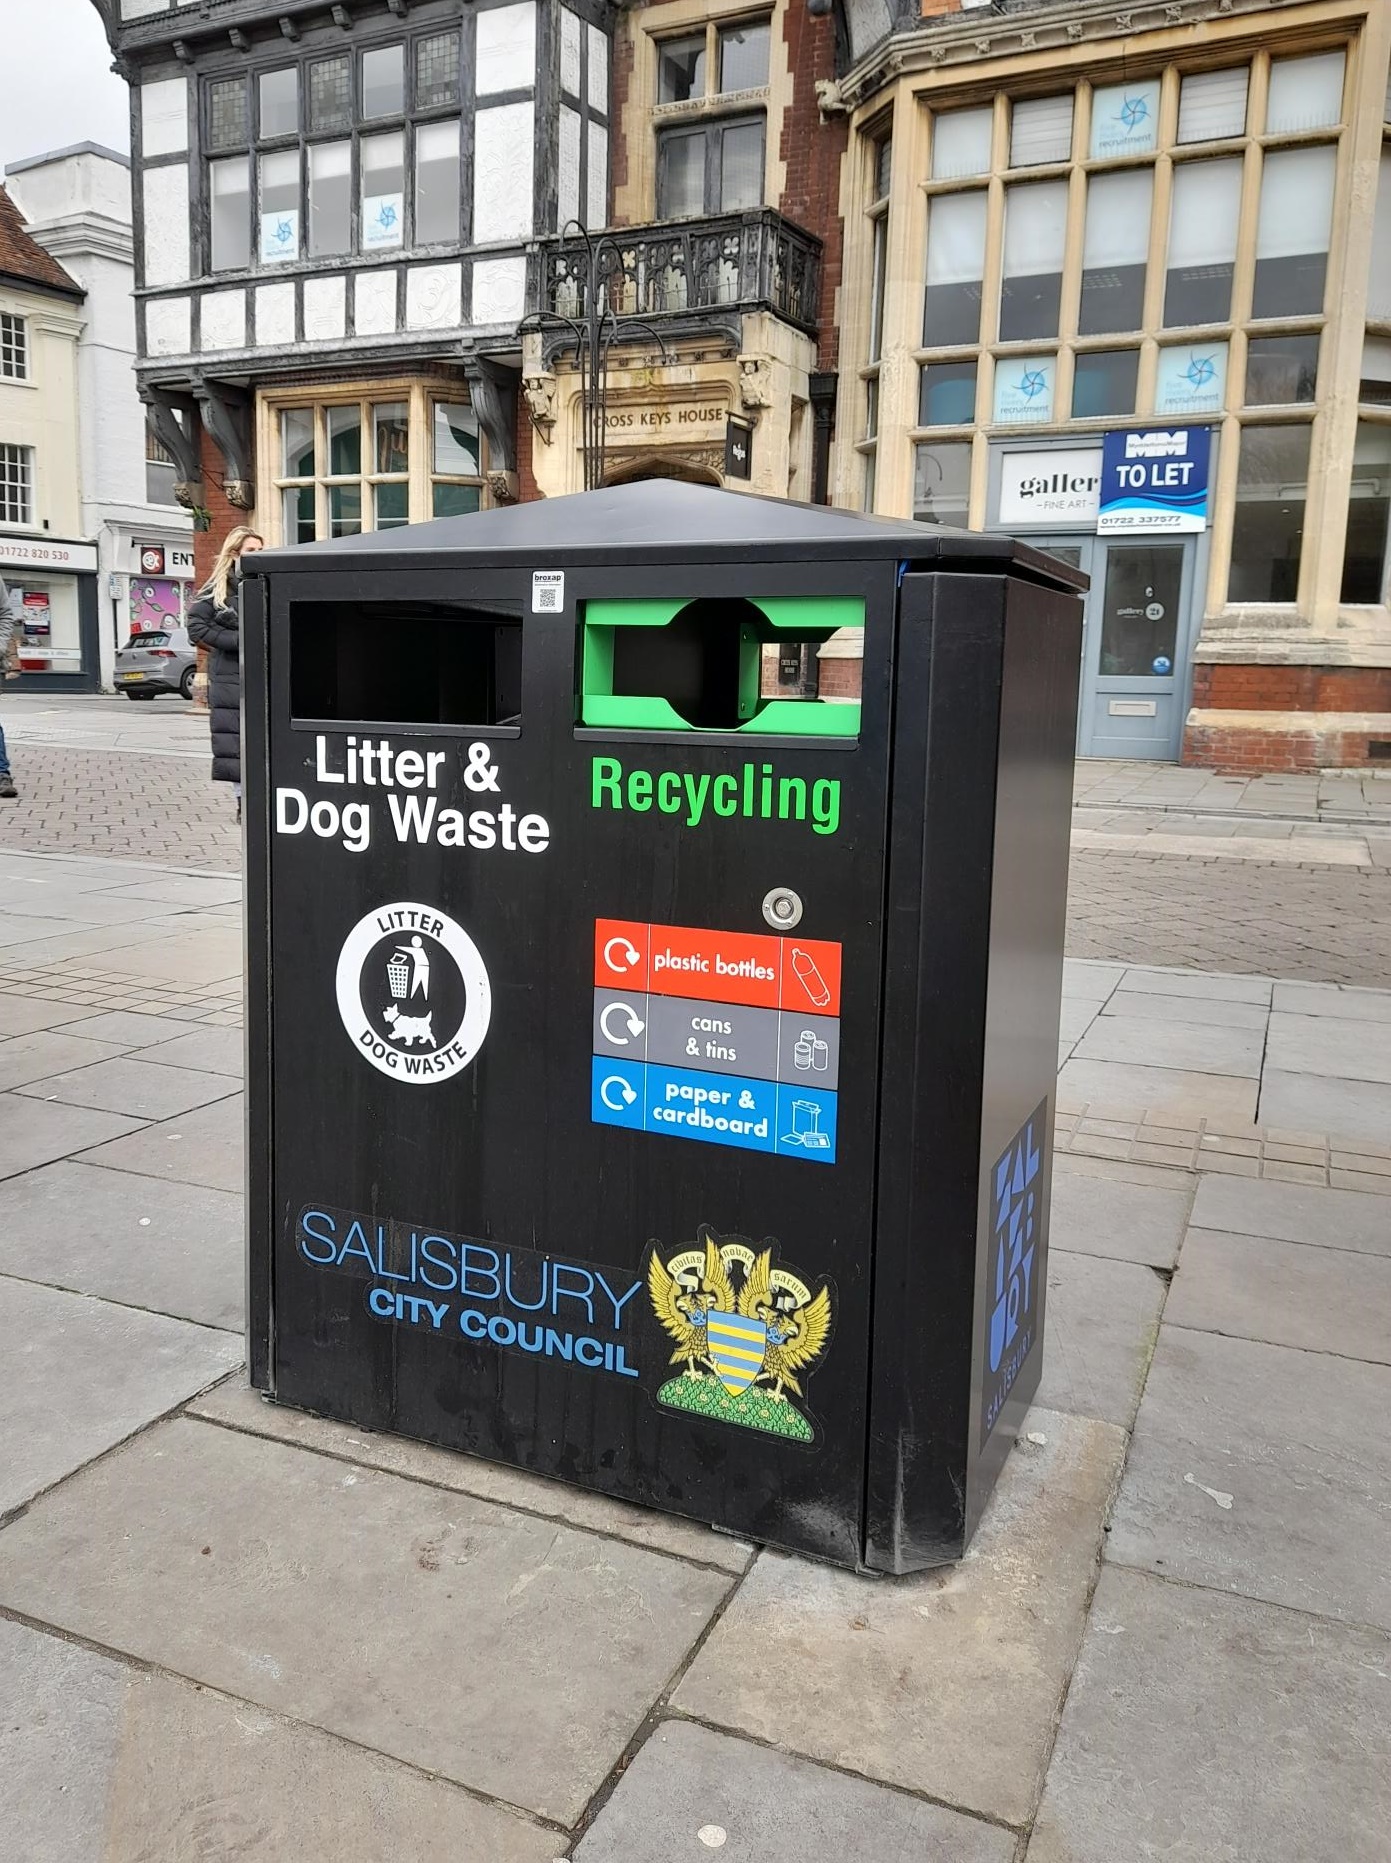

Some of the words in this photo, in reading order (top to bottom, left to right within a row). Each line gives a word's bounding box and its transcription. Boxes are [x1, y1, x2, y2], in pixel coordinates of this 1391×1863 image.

[640, 412, 671, 425] KEYS
[678, 408, 723, 423] HOUSE
[1020, 474, 1100, 499] galler
[1116, 464, 1146, 488] TO
[1151, 462, 1194, 486] LET
[1043, 500, 1065, 509] FINE
[1067, 500, 1088, 508] ART
[1101, 517, 1134, 525] 01722
[1138, 515, 1182, 523] 337577
[32, 549, 49, 559] 820
[52, 550, 69, 560] 530
[316, 735, 446, 788] Litter
[463, 741, 501, 792] &
[591, 756, 841, 835] Recycling
[275, 787, 370, 852] Dog
[387, 793, 550, 853] Waste
[376, 910, 444, 938] LITTER
[654, 948, 709, 973] plastic
[715, 953, 775, 981] bottles
[691, 1016, 732, 1034] cans
[359, 1029, 399, 1069] DOG
[404, 1041, 467, 1075] WASTE
[685, 1037, 700, 1056] &
[705, 1040, 737, 1062] tins
[665, 1082, 732, 1106] paper
[738, 1090, 756, 1109] &
[653, 1104, 768, 1138] cardboard
[301, 1210, 643, 1330] SALISBURY
[369, 1288, 450, 1329] CITY
[459, 1309, 640, 1378] COUNCIL
[987, 1327, 1032, 1430] SALISBURY
